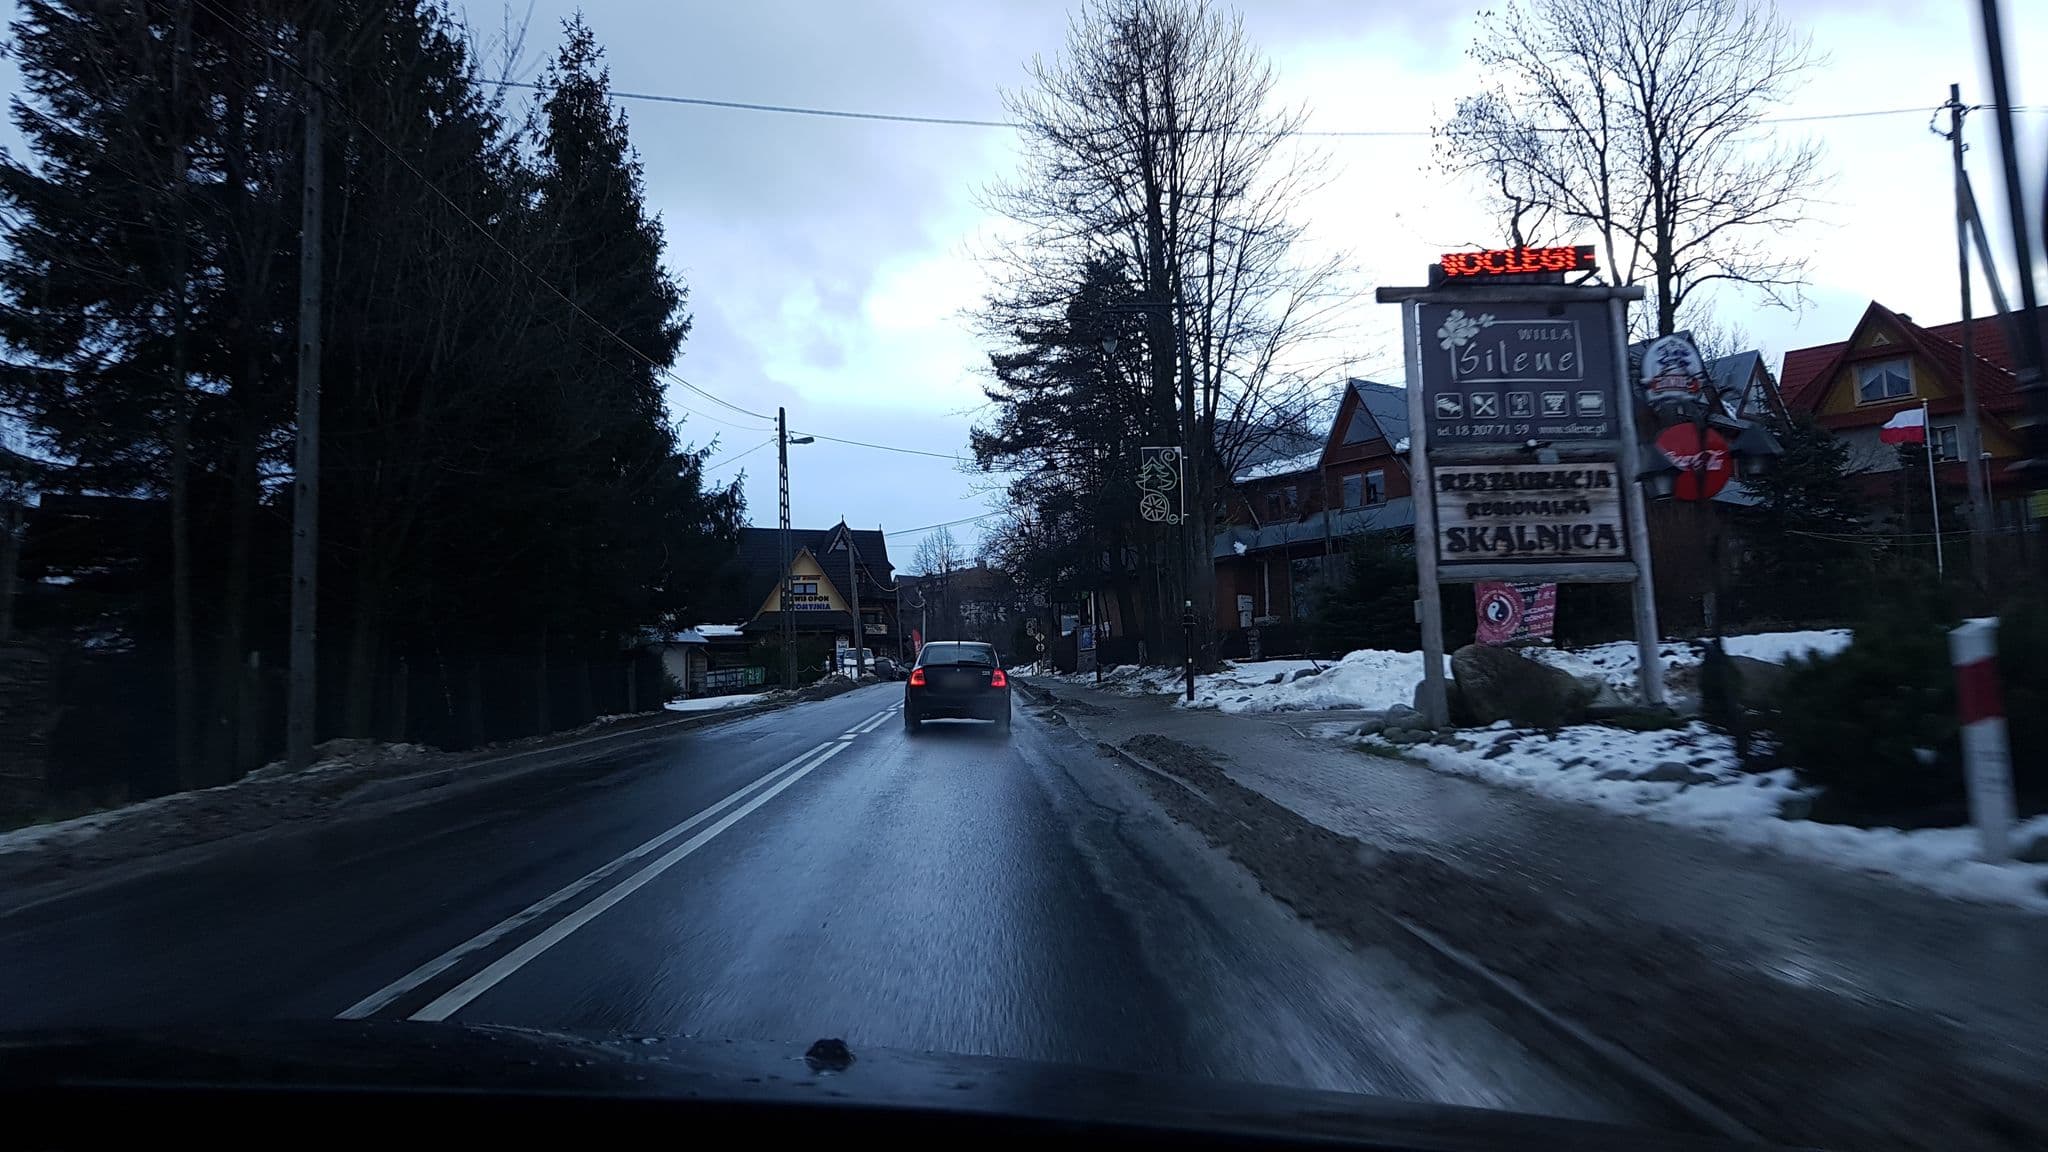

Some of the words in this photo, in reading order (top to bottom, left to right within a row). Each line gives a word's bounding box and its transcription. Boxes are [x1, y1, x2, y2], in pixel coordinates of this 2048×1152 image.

[1517, 327, 1574, 341] WILLA
[1458, 339, 1577, 376] Silene
[1455, 424, 1471, 437] 18
[1471, 424, 1495, 436] 207
[1495, 424, 1511, 436] 71
[1514, 423, 1531, 436] 59
[1439, 470, 1612, 491] RESTAURACJA
[1465, 500, 1591, 519] REGIONALNA
[1446, 523, 1620, 553] SKALNICA
